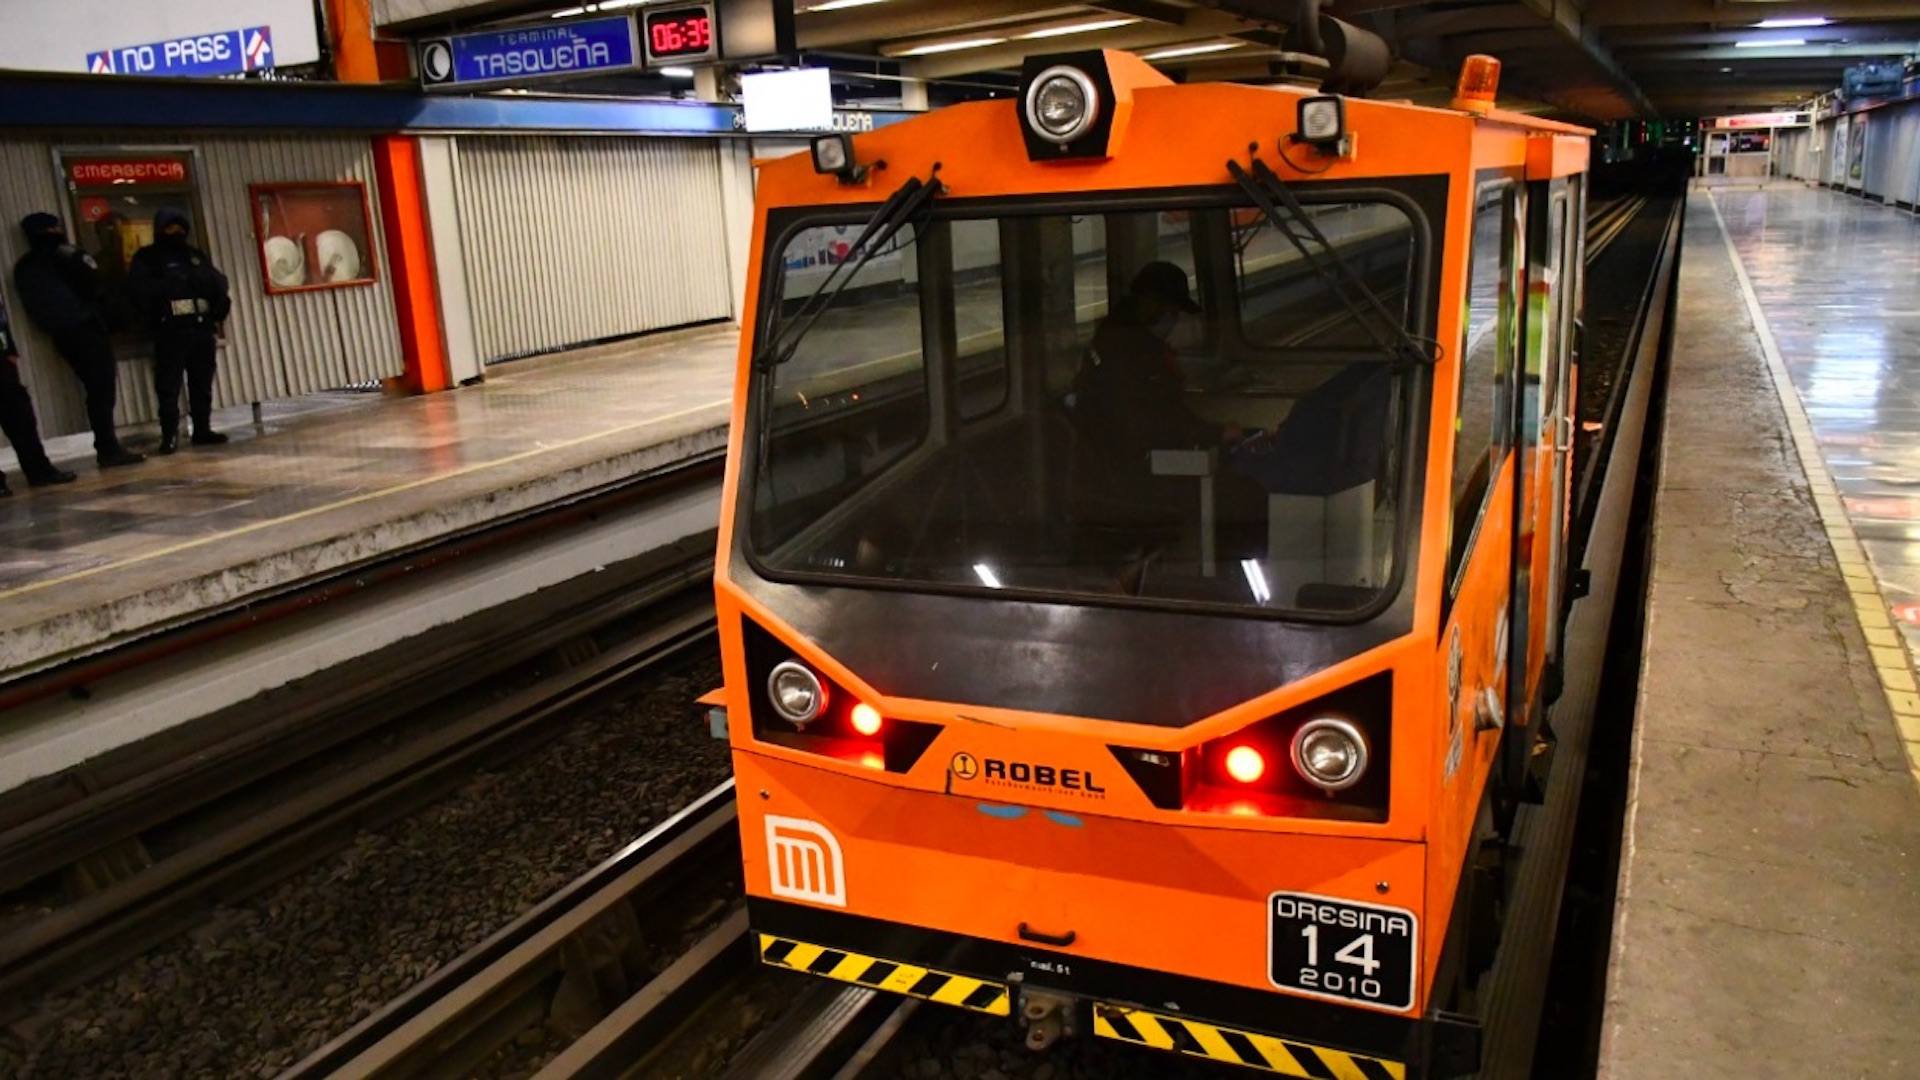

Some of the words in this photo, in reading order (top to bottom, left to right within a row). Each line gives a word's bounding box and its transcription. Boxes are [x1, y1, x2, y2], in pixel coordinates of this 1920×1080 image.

[499, 26, 578, 46] TERMINAL
[652, 17, 712, 51] 06:39
[122, 46, 155, 73] NO
[163, 34, 231, 67] PASE
[473, 37, 610, 77] TASQUEÑA
[73, 162, 184, 179] EMERGENCIA
[984, 758, 1105, 793] ROBEL
[1277, 898, 1408, 937] DRESINA
[1301, 924, 1381, 976] 14
[1299, 967, 1382, 998] 2010
